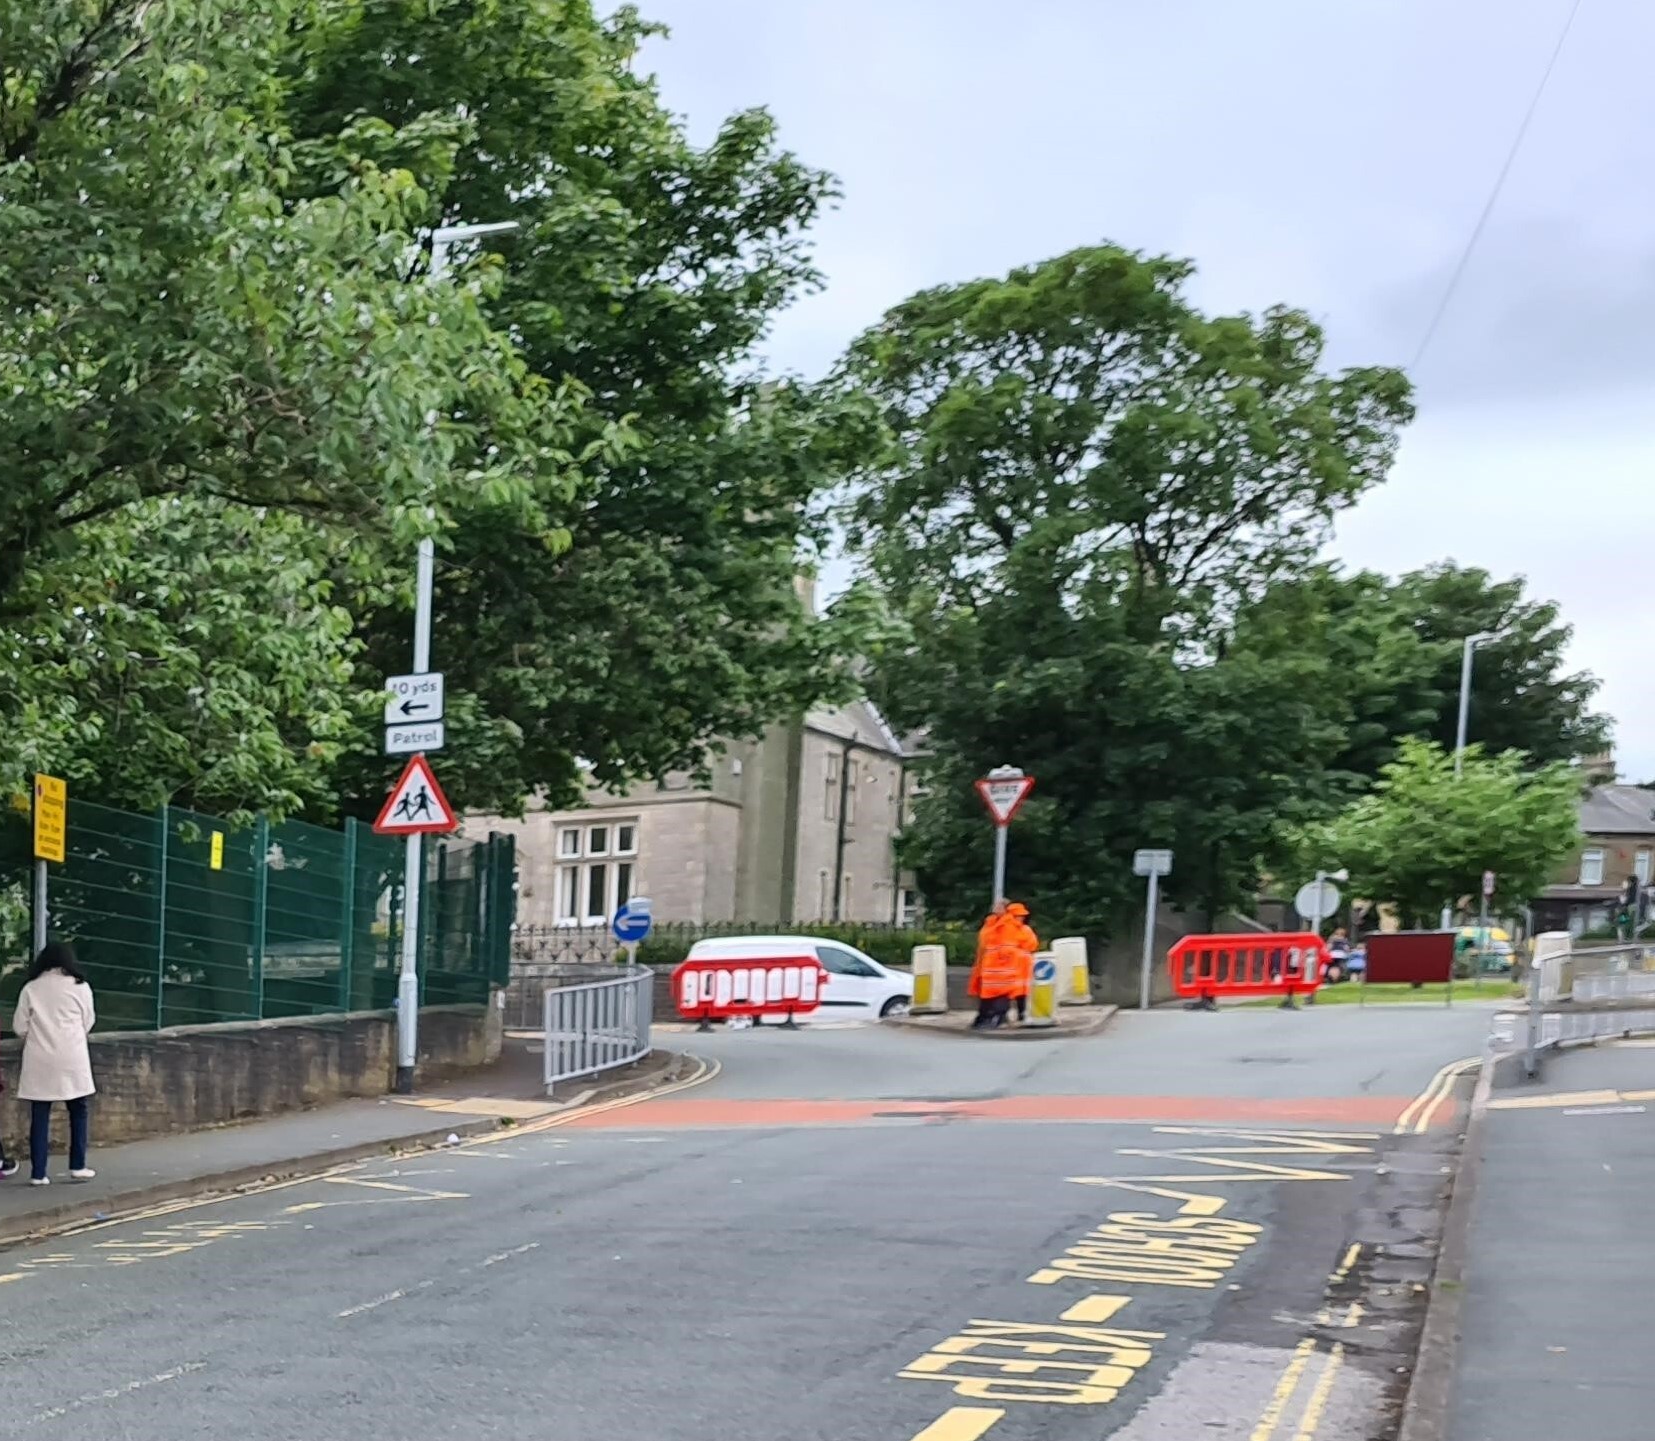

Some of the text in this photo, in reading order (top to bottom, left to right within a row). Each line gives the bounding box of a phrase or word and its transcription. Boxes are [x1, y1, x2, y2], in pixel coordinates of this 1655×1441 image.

[393, 729, 437, 745] Patrol
[1026, 1211, 1264, 1288] SCHOOL
[895, 1318, 1167, 1404] KEEP
